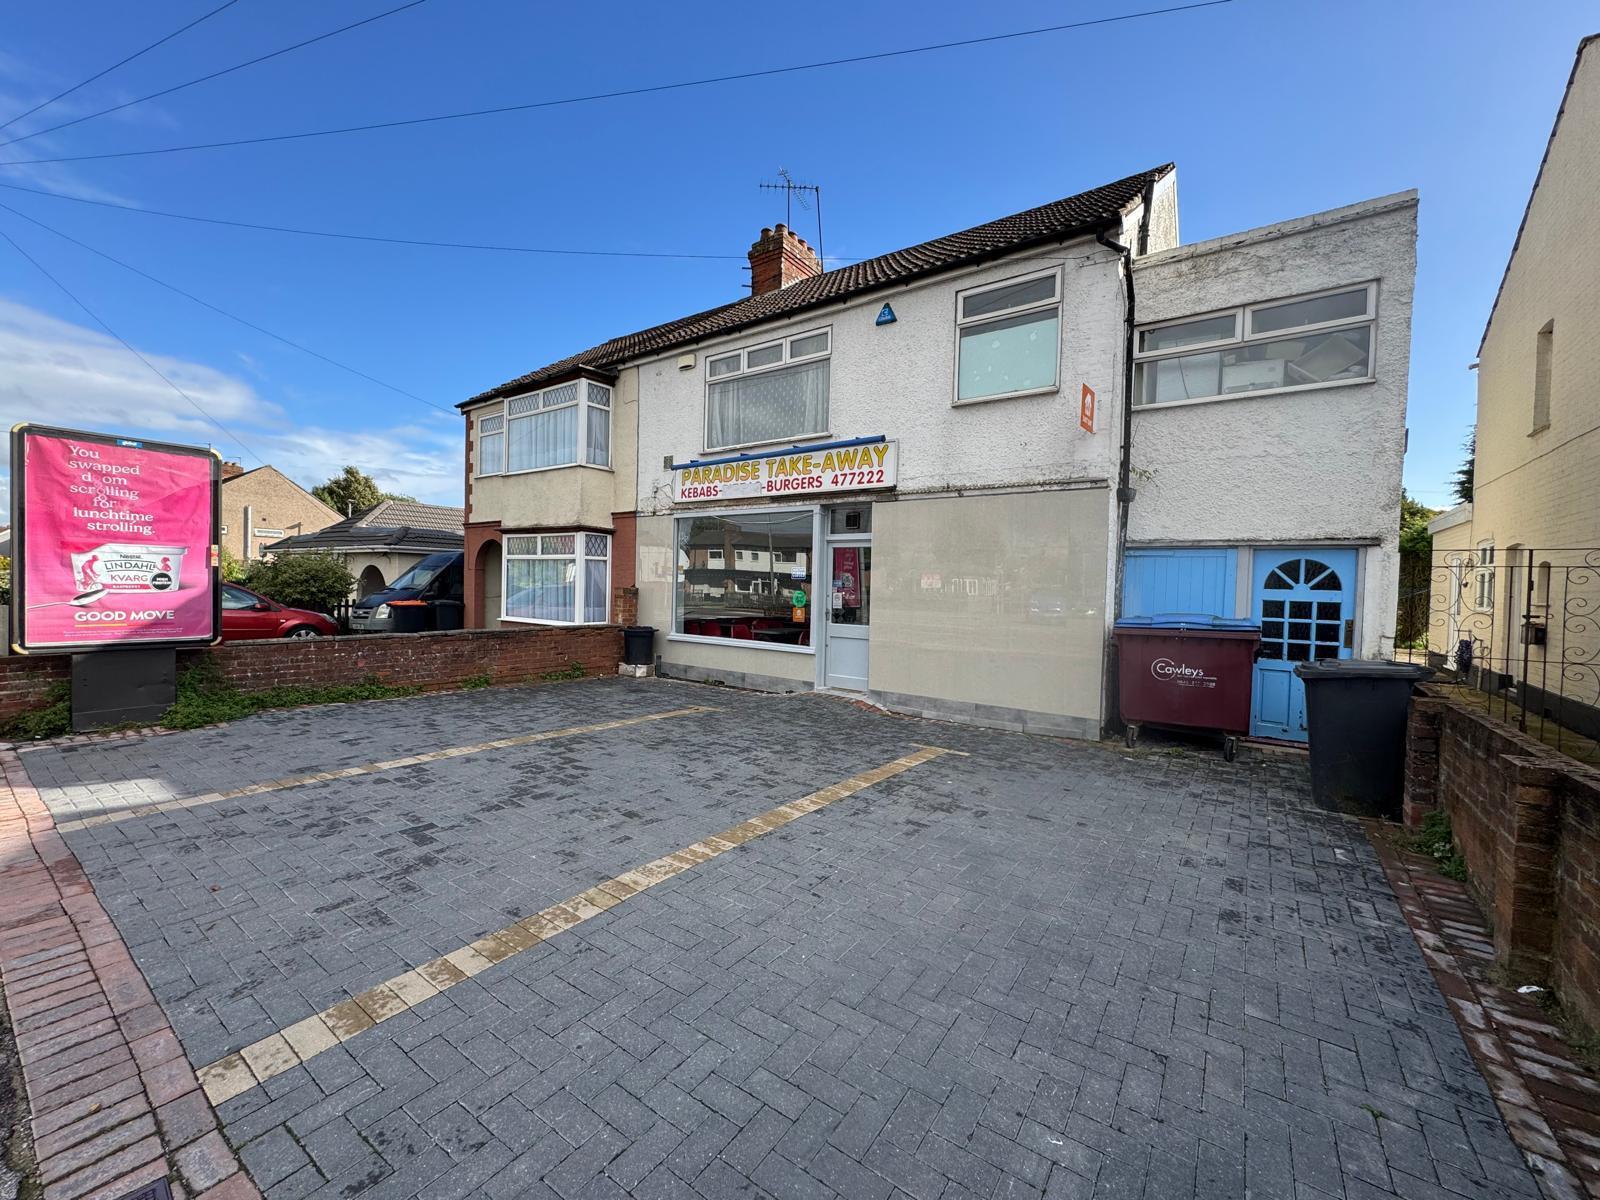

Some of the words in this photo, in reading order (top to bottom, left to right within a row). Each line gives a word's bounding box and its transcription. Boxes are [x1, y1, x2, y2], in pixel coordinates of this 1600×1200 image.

[68, 445, 100, 459] You
[68, 460, 140, 475] swapped
[681, 460, 760, 486] PARADISE
[766, 444, 889, 478] TAKE-AWAY
[831, 469, 884, 487] 477222
[69, 485, 140, 500] scrolling
[93, 496, 117, 508] for
[73, 507, 154, 521] lunchtime
[110, 574, 149, 583] KVARG
[74, 611, 127, 622] GOOD
[130, 610, 175, 621] MOVE
[1156, 663, 1204, 678] Cawleys
